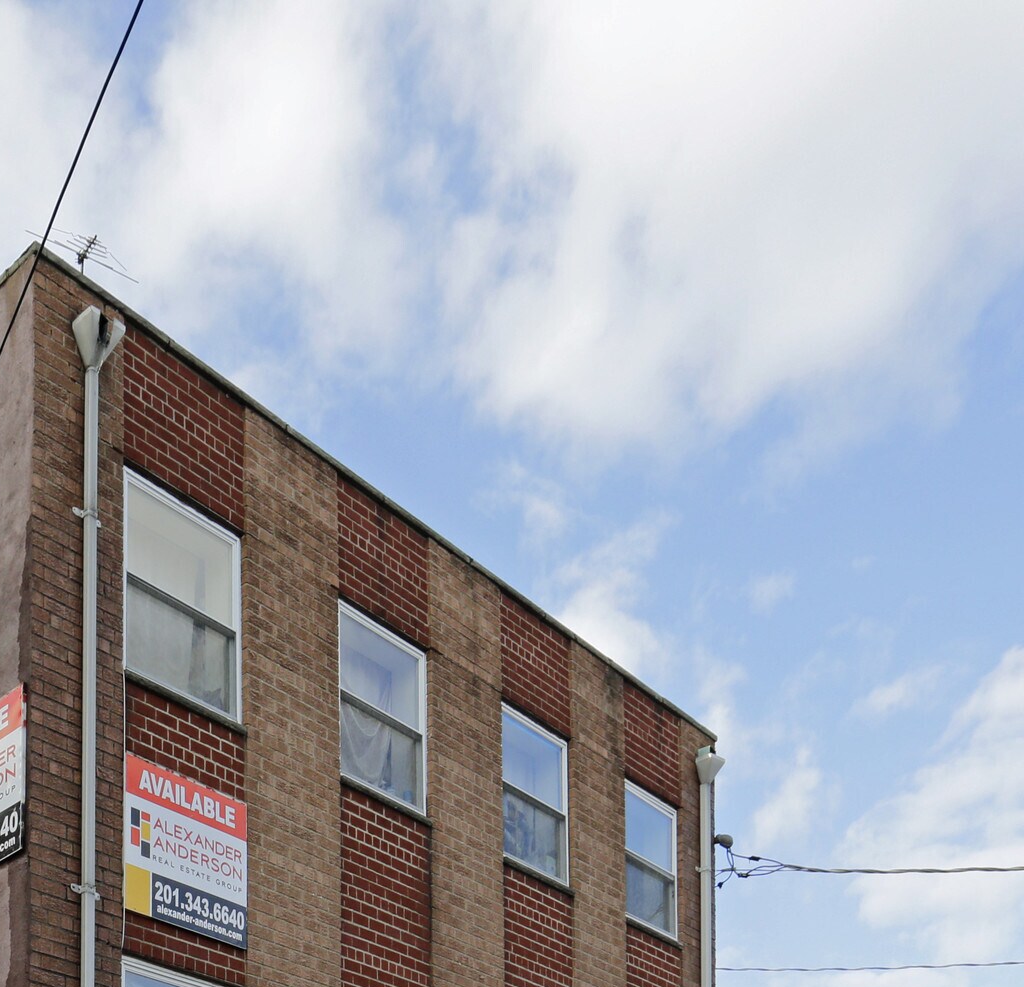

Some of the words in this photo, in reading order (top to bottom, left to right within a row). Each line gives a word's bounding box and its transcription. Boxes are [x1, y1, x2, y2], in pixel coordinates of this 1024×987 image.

[139, 770, 236, 829] AVAILABLE
[152, 817, 242, 864] ALEXANDER
[152, 836, 243, 882] ANDERSON
[152, 854, 175, 869] REAL
[180, 864, 211, 882] ESTATE
[216, 878, 243, 894] GROUP
[154, 881, 245, 931] 201.343.6640
[156, 903, 243, 942] alexander-anderson.com
